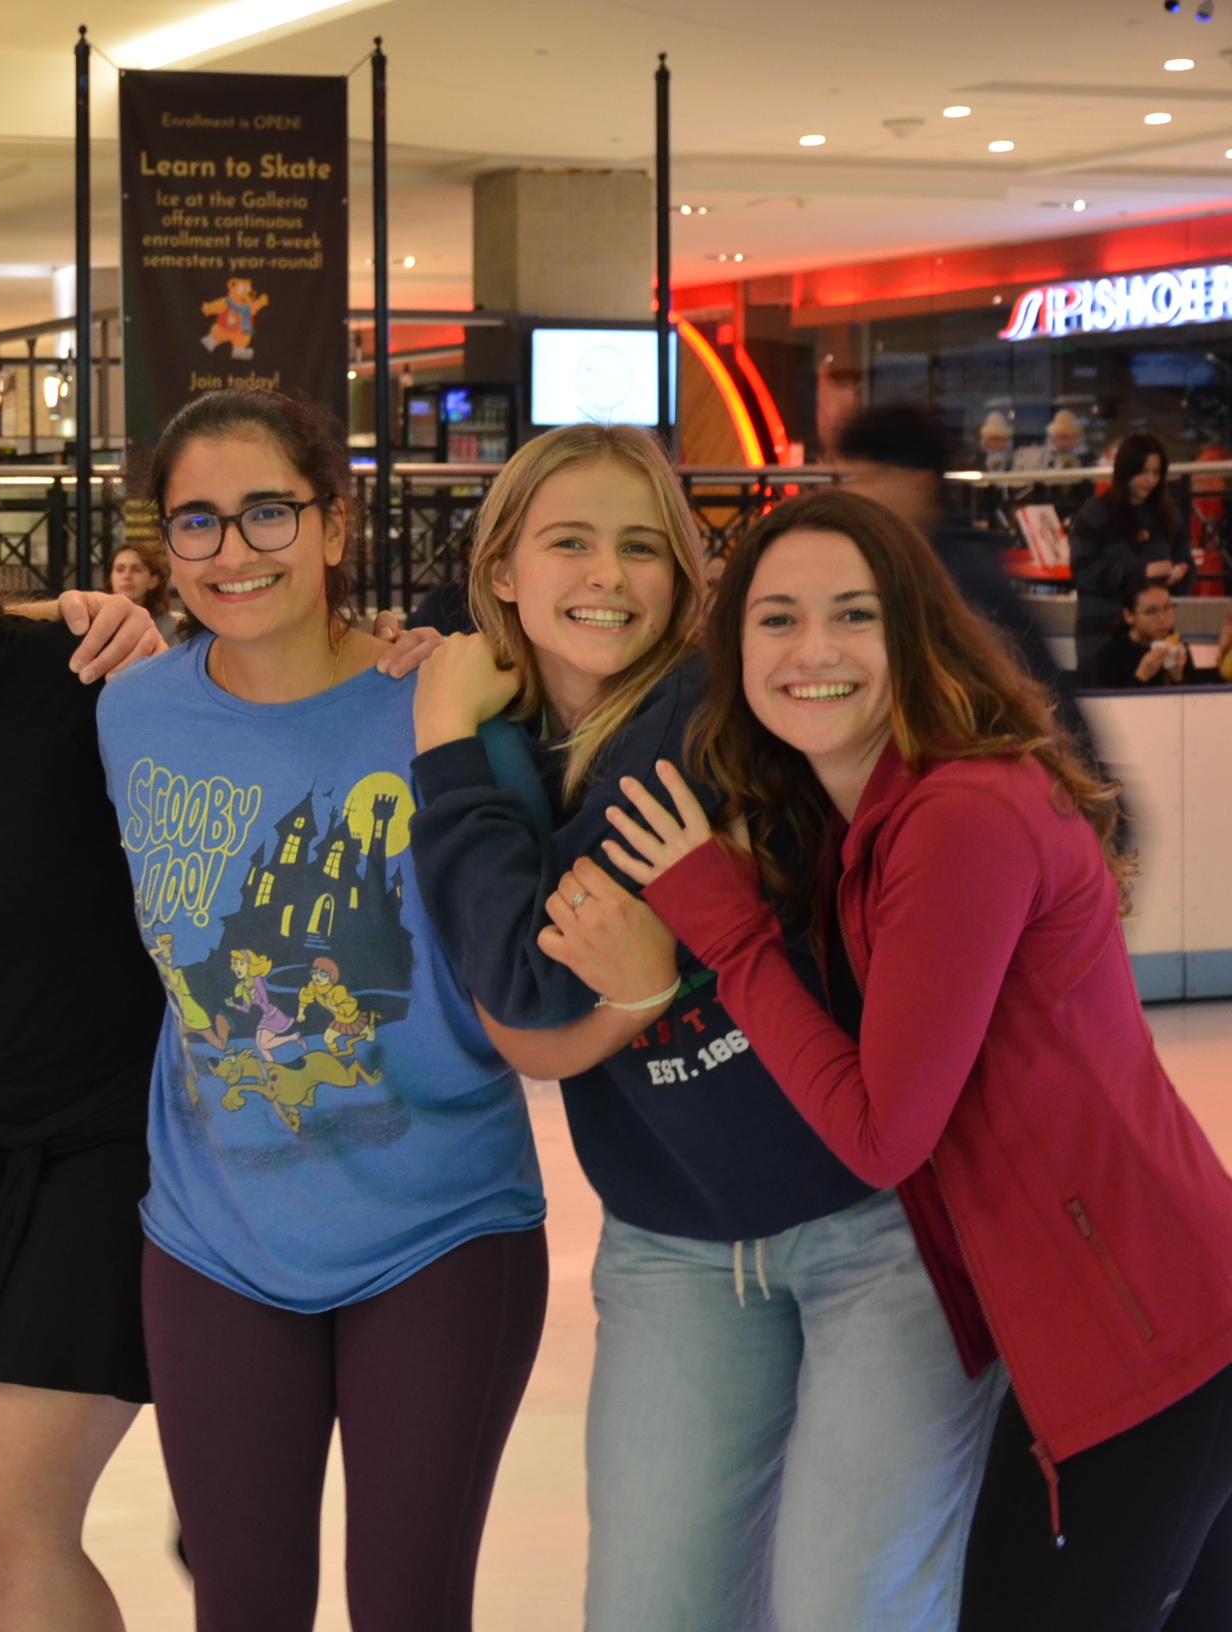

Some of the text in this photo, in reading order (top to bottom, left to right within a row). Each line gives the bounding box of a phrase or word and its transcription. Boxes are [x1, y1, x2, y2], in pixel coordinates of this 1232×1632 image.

[162, 111, 301, 131] Enrollment is OPEN!
[140, 150, 332, 180] Learn to Skate
[156, 189, 309, 210] Ice at the Galleria
[162, 209, 304, 230] offers continuous
[142, 230, 322, 250] enrollment for 8-week
[143, 252, 324, 273] semesters year-round!
[190, 370, 280, 392] Join today!
[124, 757, 262, 856] SCOOBY
[138, 845, 228, 928] DOO!
[646, 1057, 700, 1085] EST.
